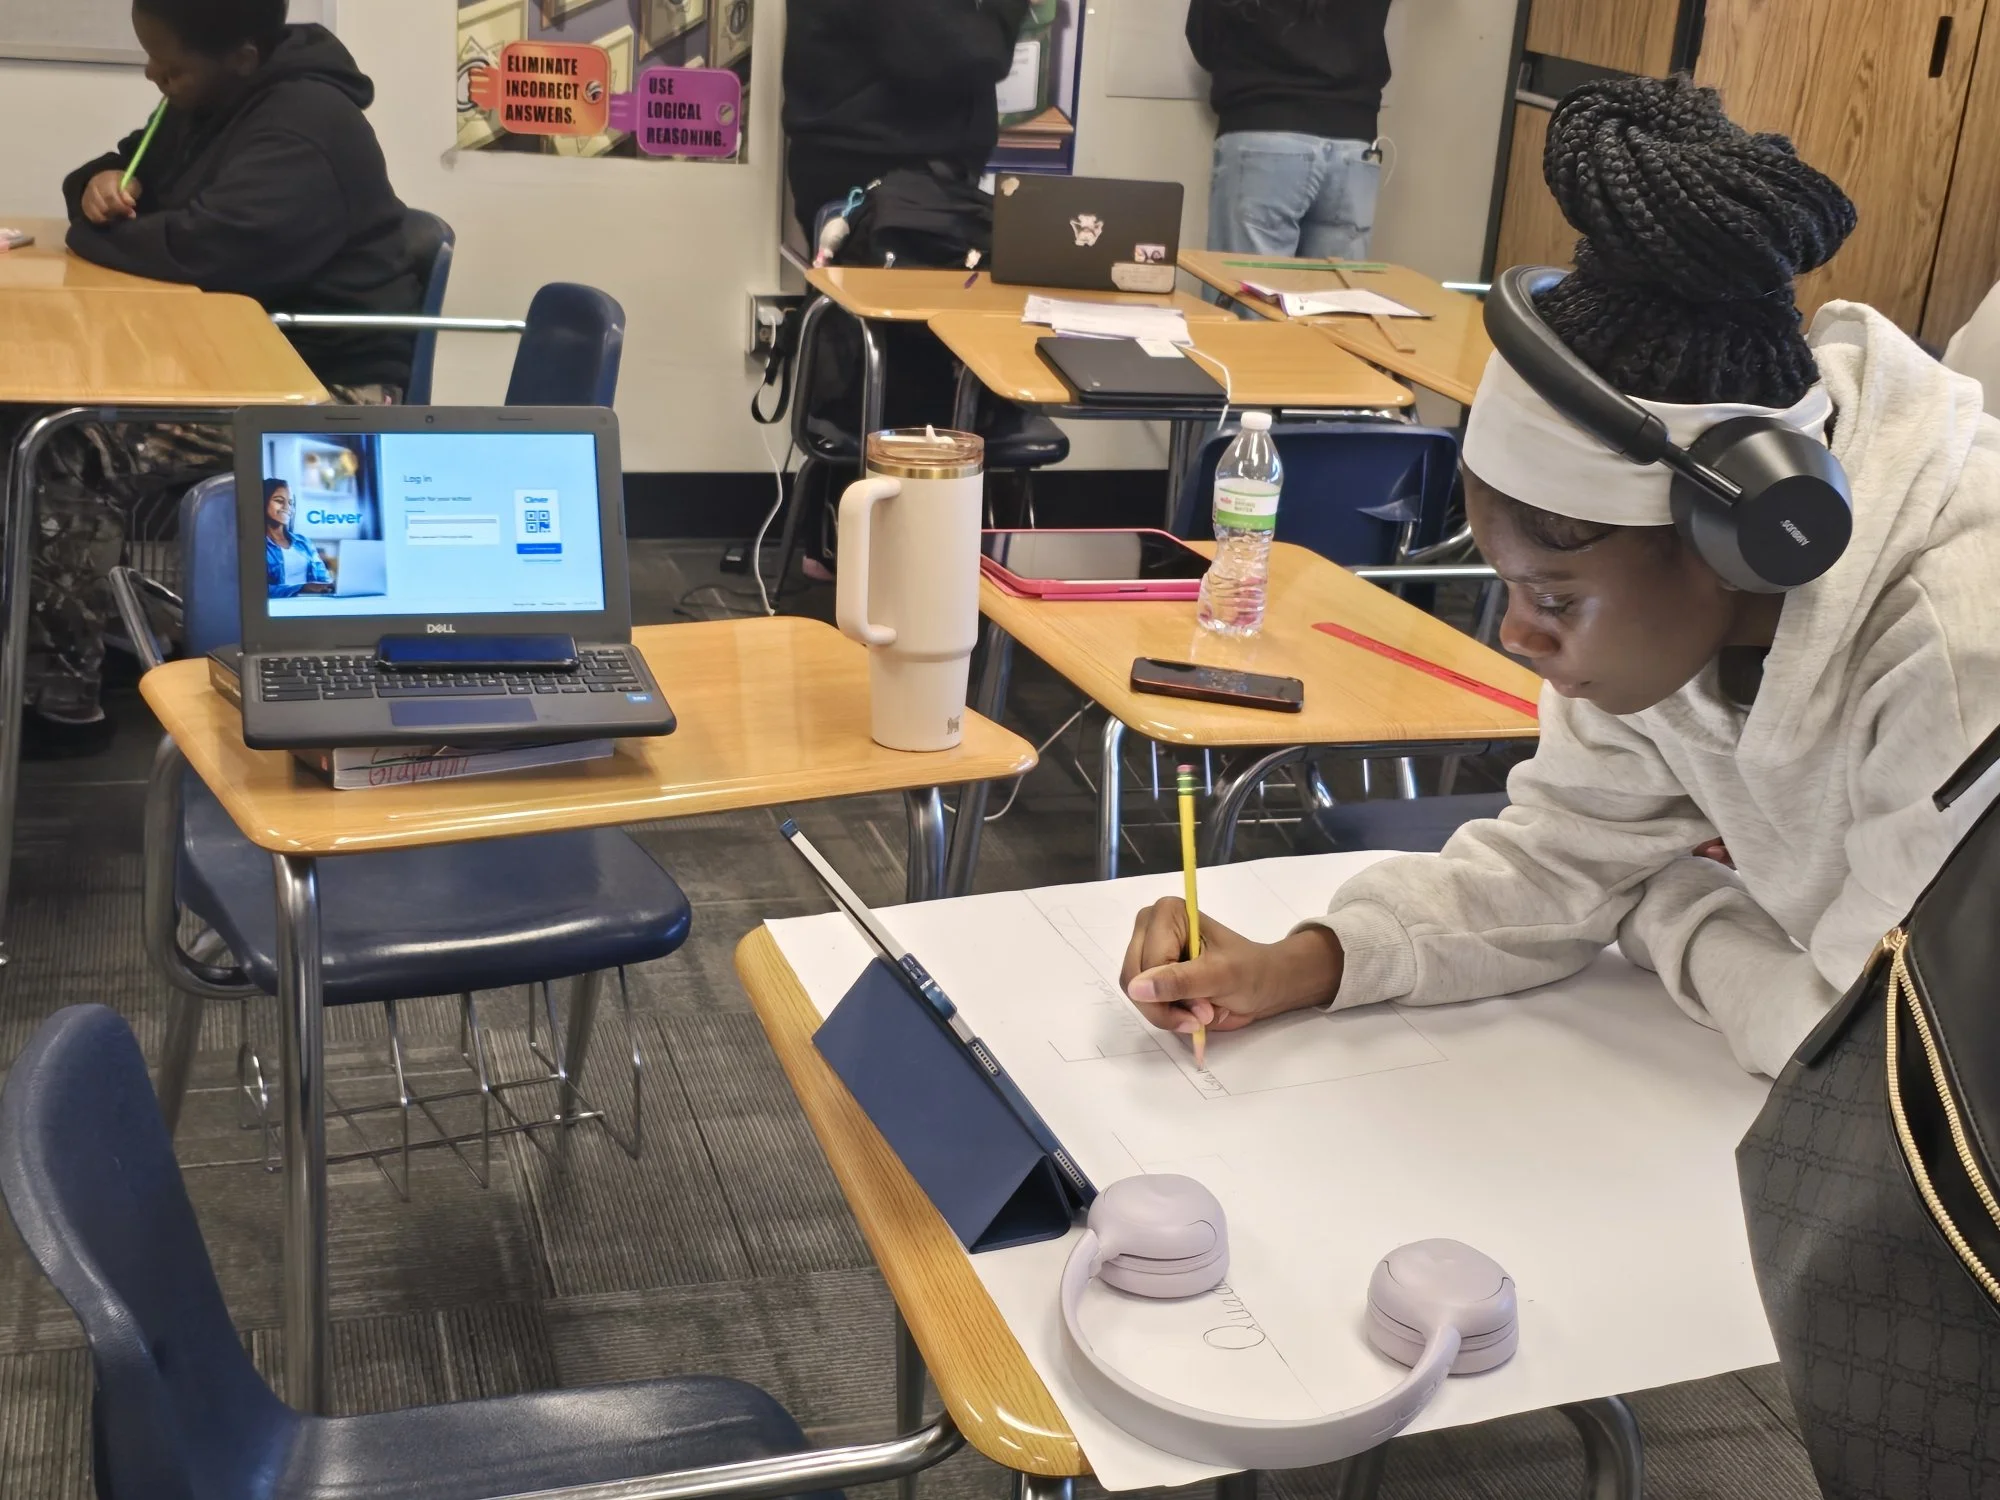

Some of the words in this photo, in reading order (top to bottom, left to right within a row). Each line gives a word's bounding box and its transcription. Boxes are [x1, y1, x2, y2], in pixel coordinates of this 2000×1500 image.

[507, 55, 578, 76] ELIMINATE
[505, 79, 580, 100] INCORRECT
[648, 77, 674, 95] USE
[505, 104, 577, 125] ANSWERS.
[647, 101, 702, 121] LOGICAL
[646, 127, 727, 148] REASONING.
[403, 475, 421, 484] Log
[307, 510, 363, 524] Clever
[427, 623, 457, 634] DELL
